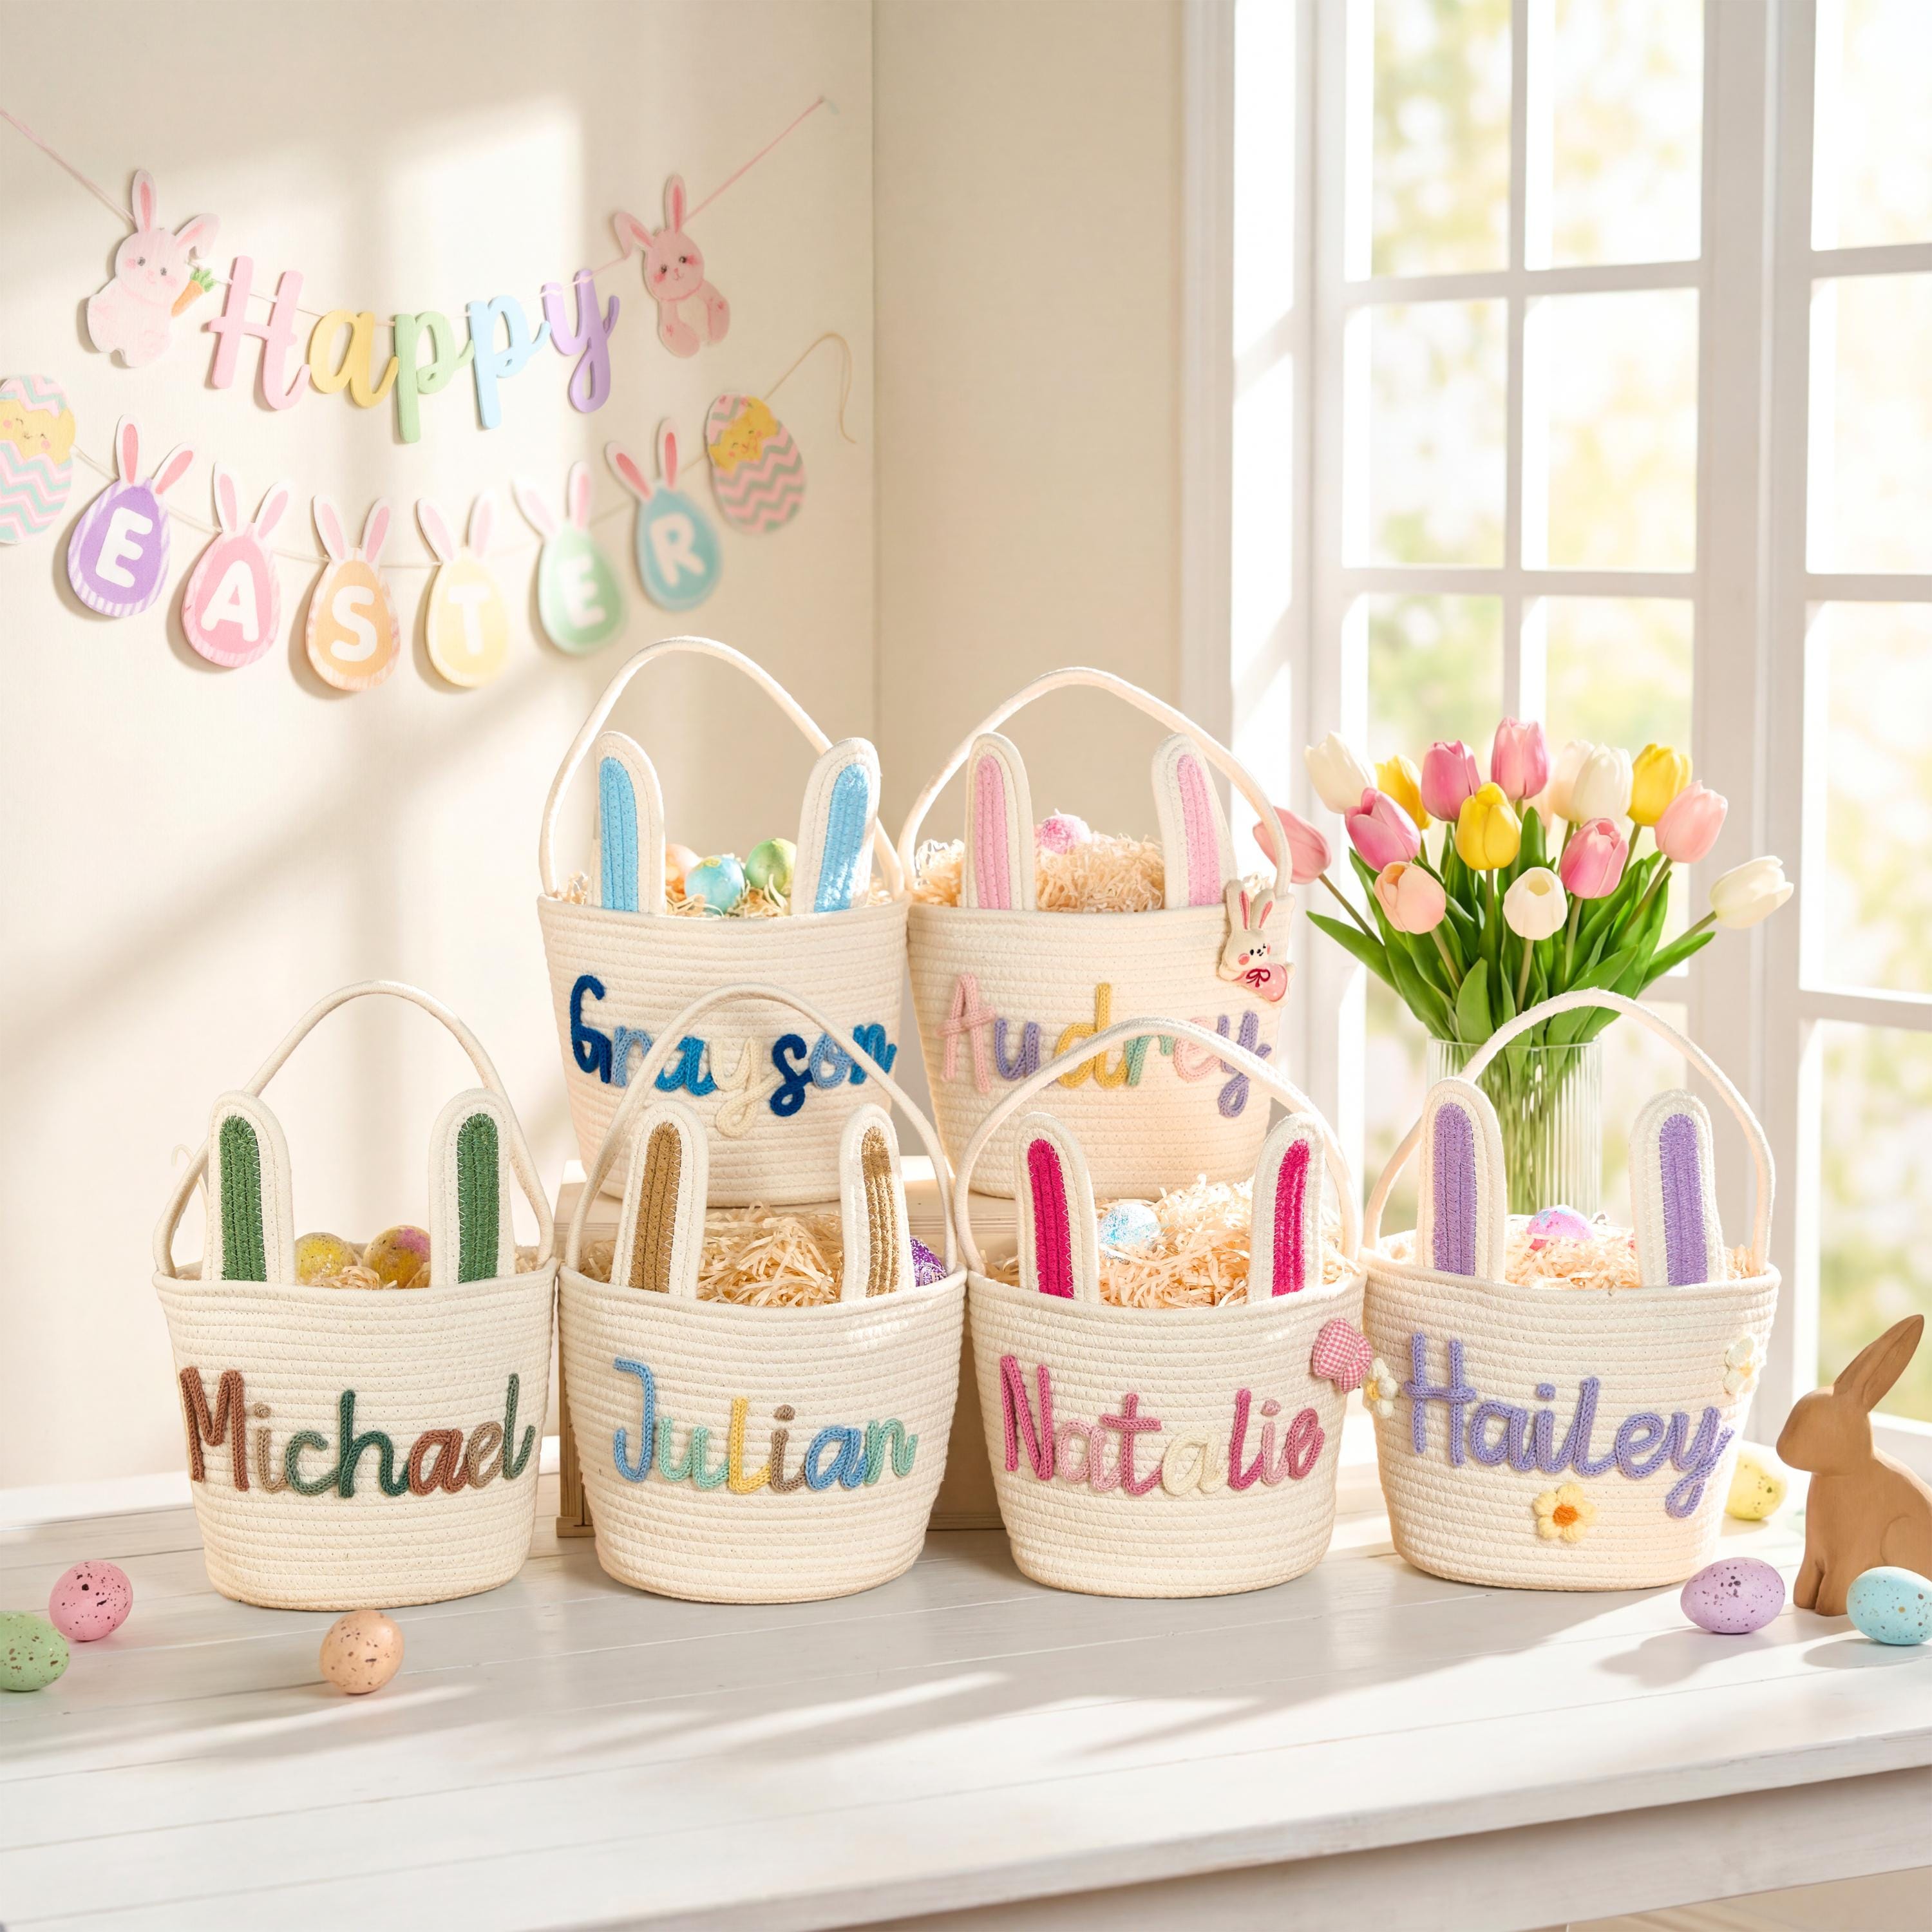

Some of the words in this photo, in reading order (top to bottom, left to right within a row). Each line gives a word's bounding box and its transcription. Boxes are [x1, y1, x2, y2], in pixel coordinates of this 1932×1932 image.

[202, 256, 620, 443] Happy
[95, 507, 706, 662] EASTER
[570, 974, 897, 1137] Grayson
[938, 973, 1272, 1117] Audrey
[179, 1366, 536, 1498] Michael
[613, 1356, 918, 1495] Julian
[999, 1355, 1325, 1495] Natalie
[1402, 1332, 1736, 1519] Hailey
